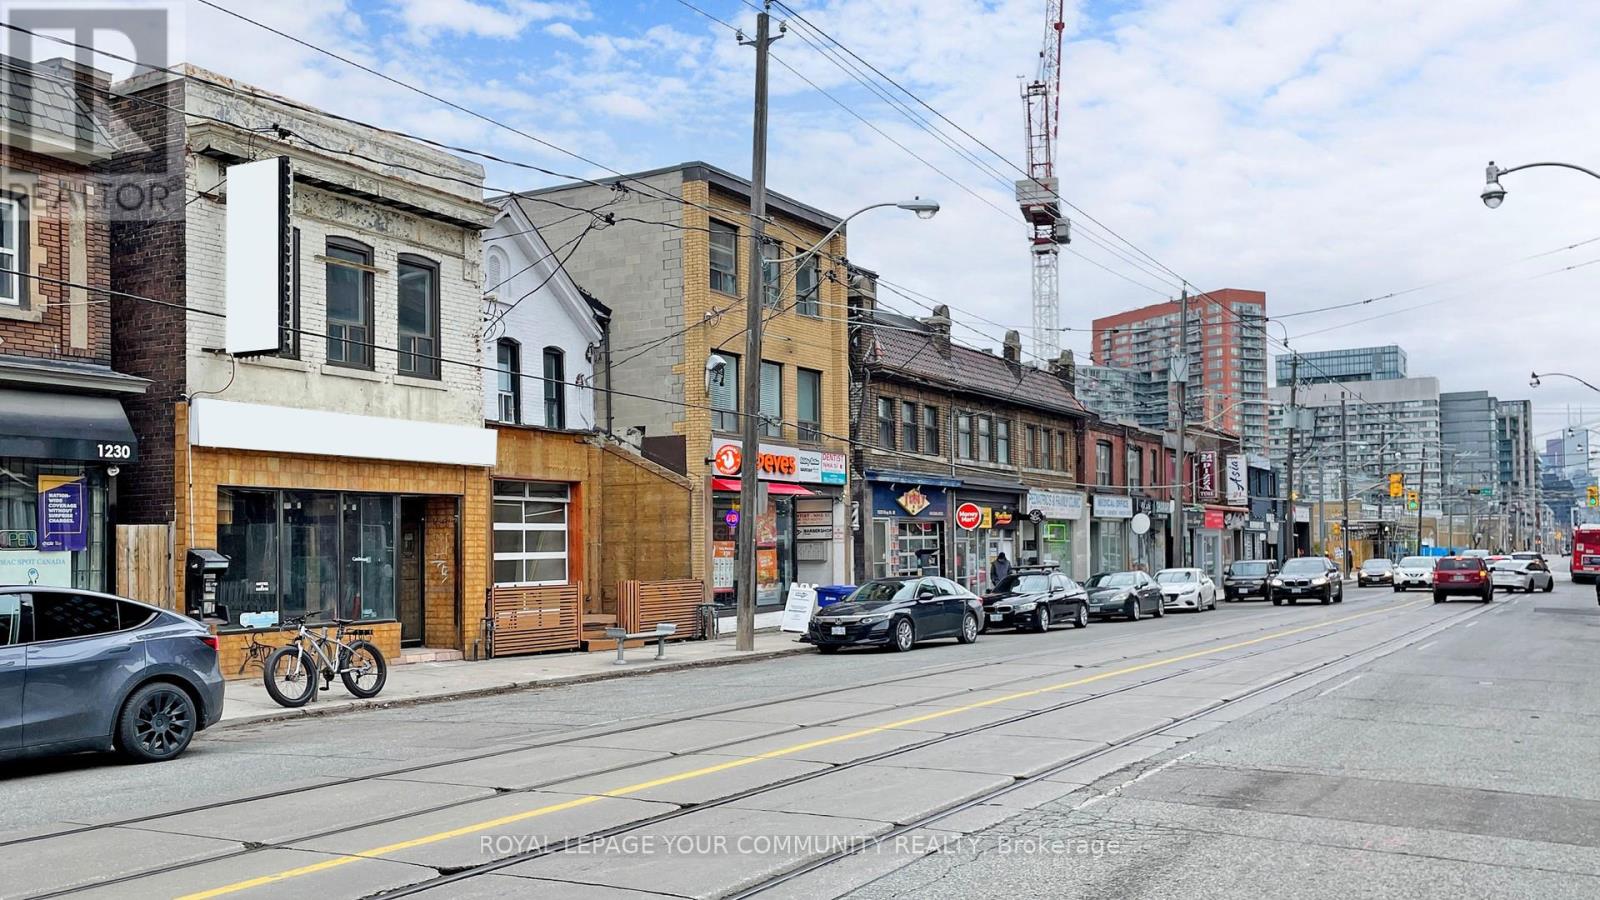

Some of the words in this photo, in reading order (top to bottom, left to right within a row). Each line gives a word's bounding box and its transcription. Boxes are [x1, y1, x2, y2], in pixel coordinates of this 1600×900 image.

[97, 444, 131, 459] 1230
[822, 453, 844, 462] DENTIST
[756, 452, 796, 475] peyes
[1202, 462, 1212, 491] PIZZA
